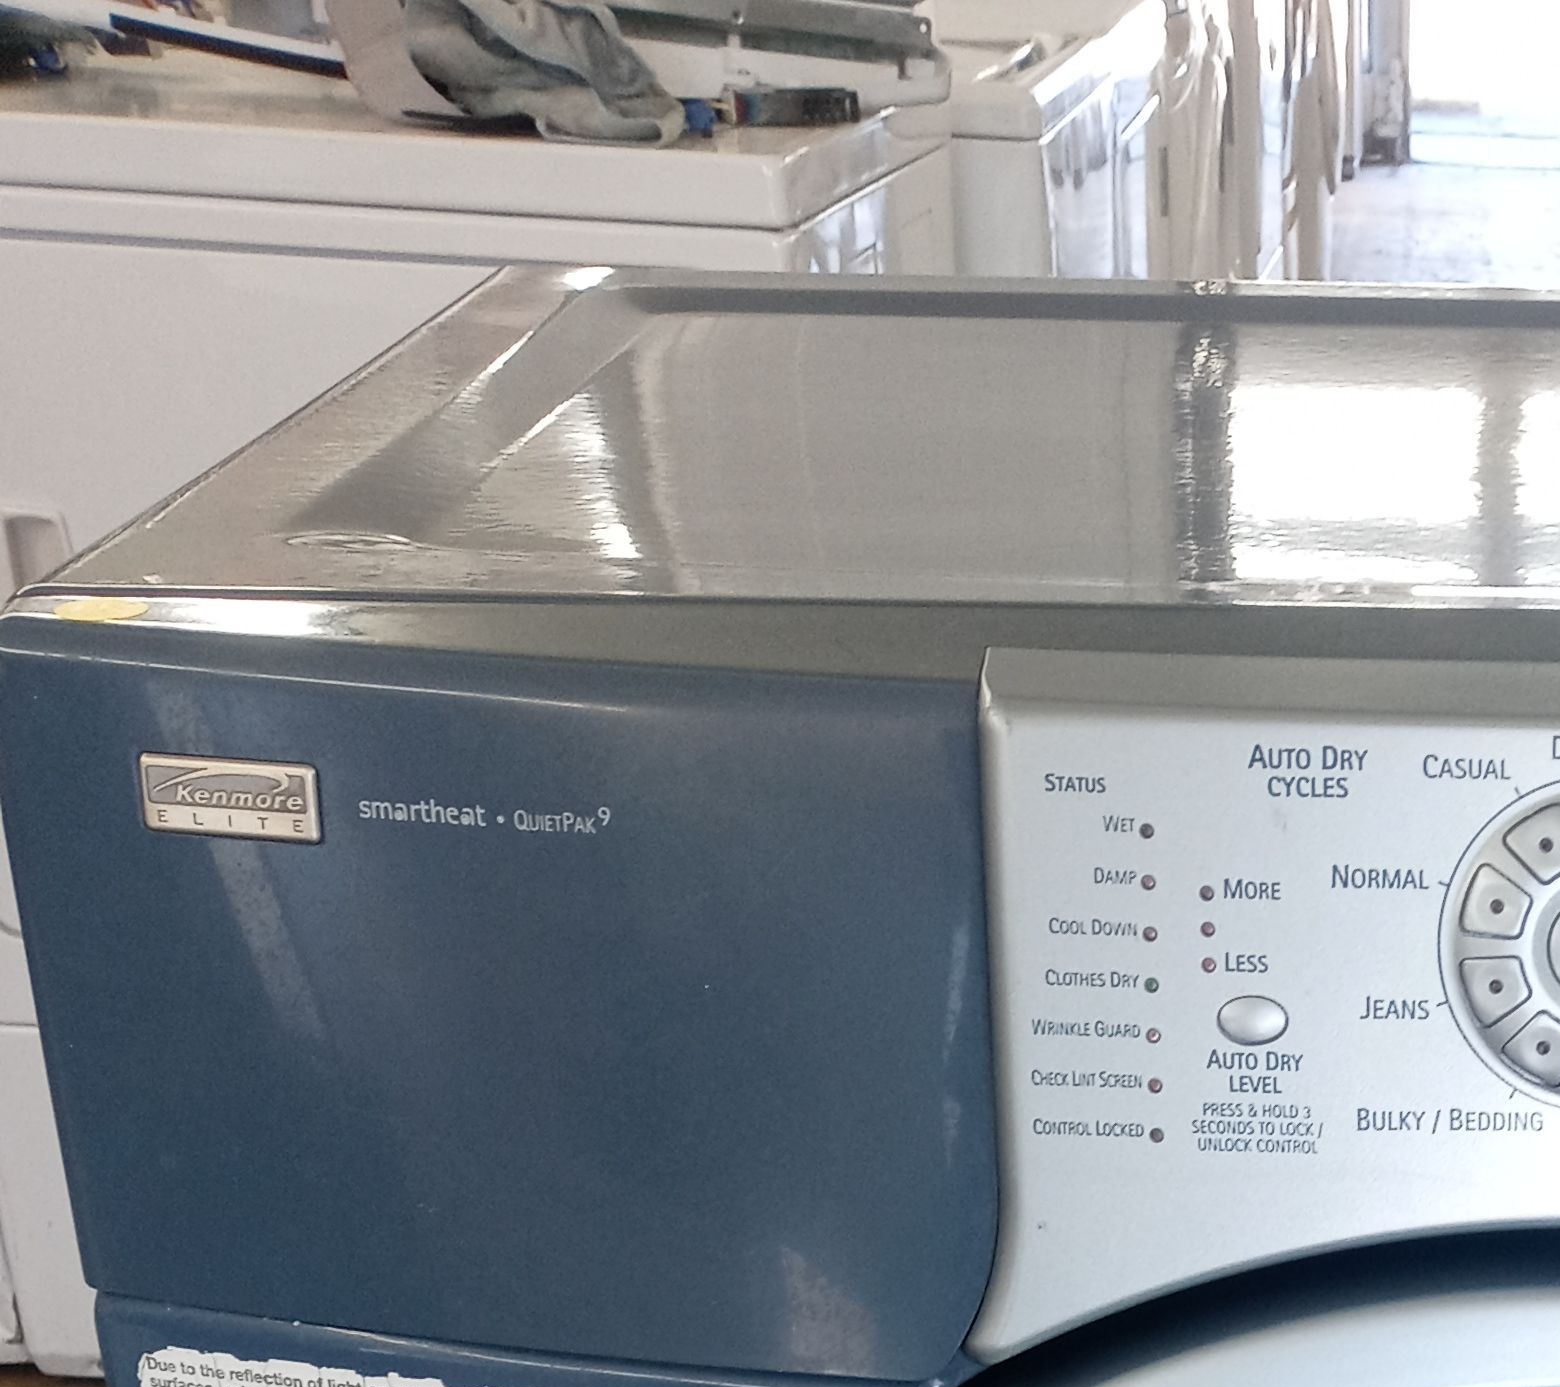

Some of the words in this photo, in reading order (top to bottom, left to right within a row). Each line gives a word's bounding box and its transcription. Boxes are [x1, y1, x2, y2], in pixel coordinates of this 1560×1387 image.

[175, 784, 303, 811] Kenmore
[156, 810, 305, 834] ELITE
[1303, 1103, 1311, 1119] 3
[146, 1356, 176, 1373] Due
[181, 1363, 195, 1375] to
[200, 1364, 225, 1379] the
